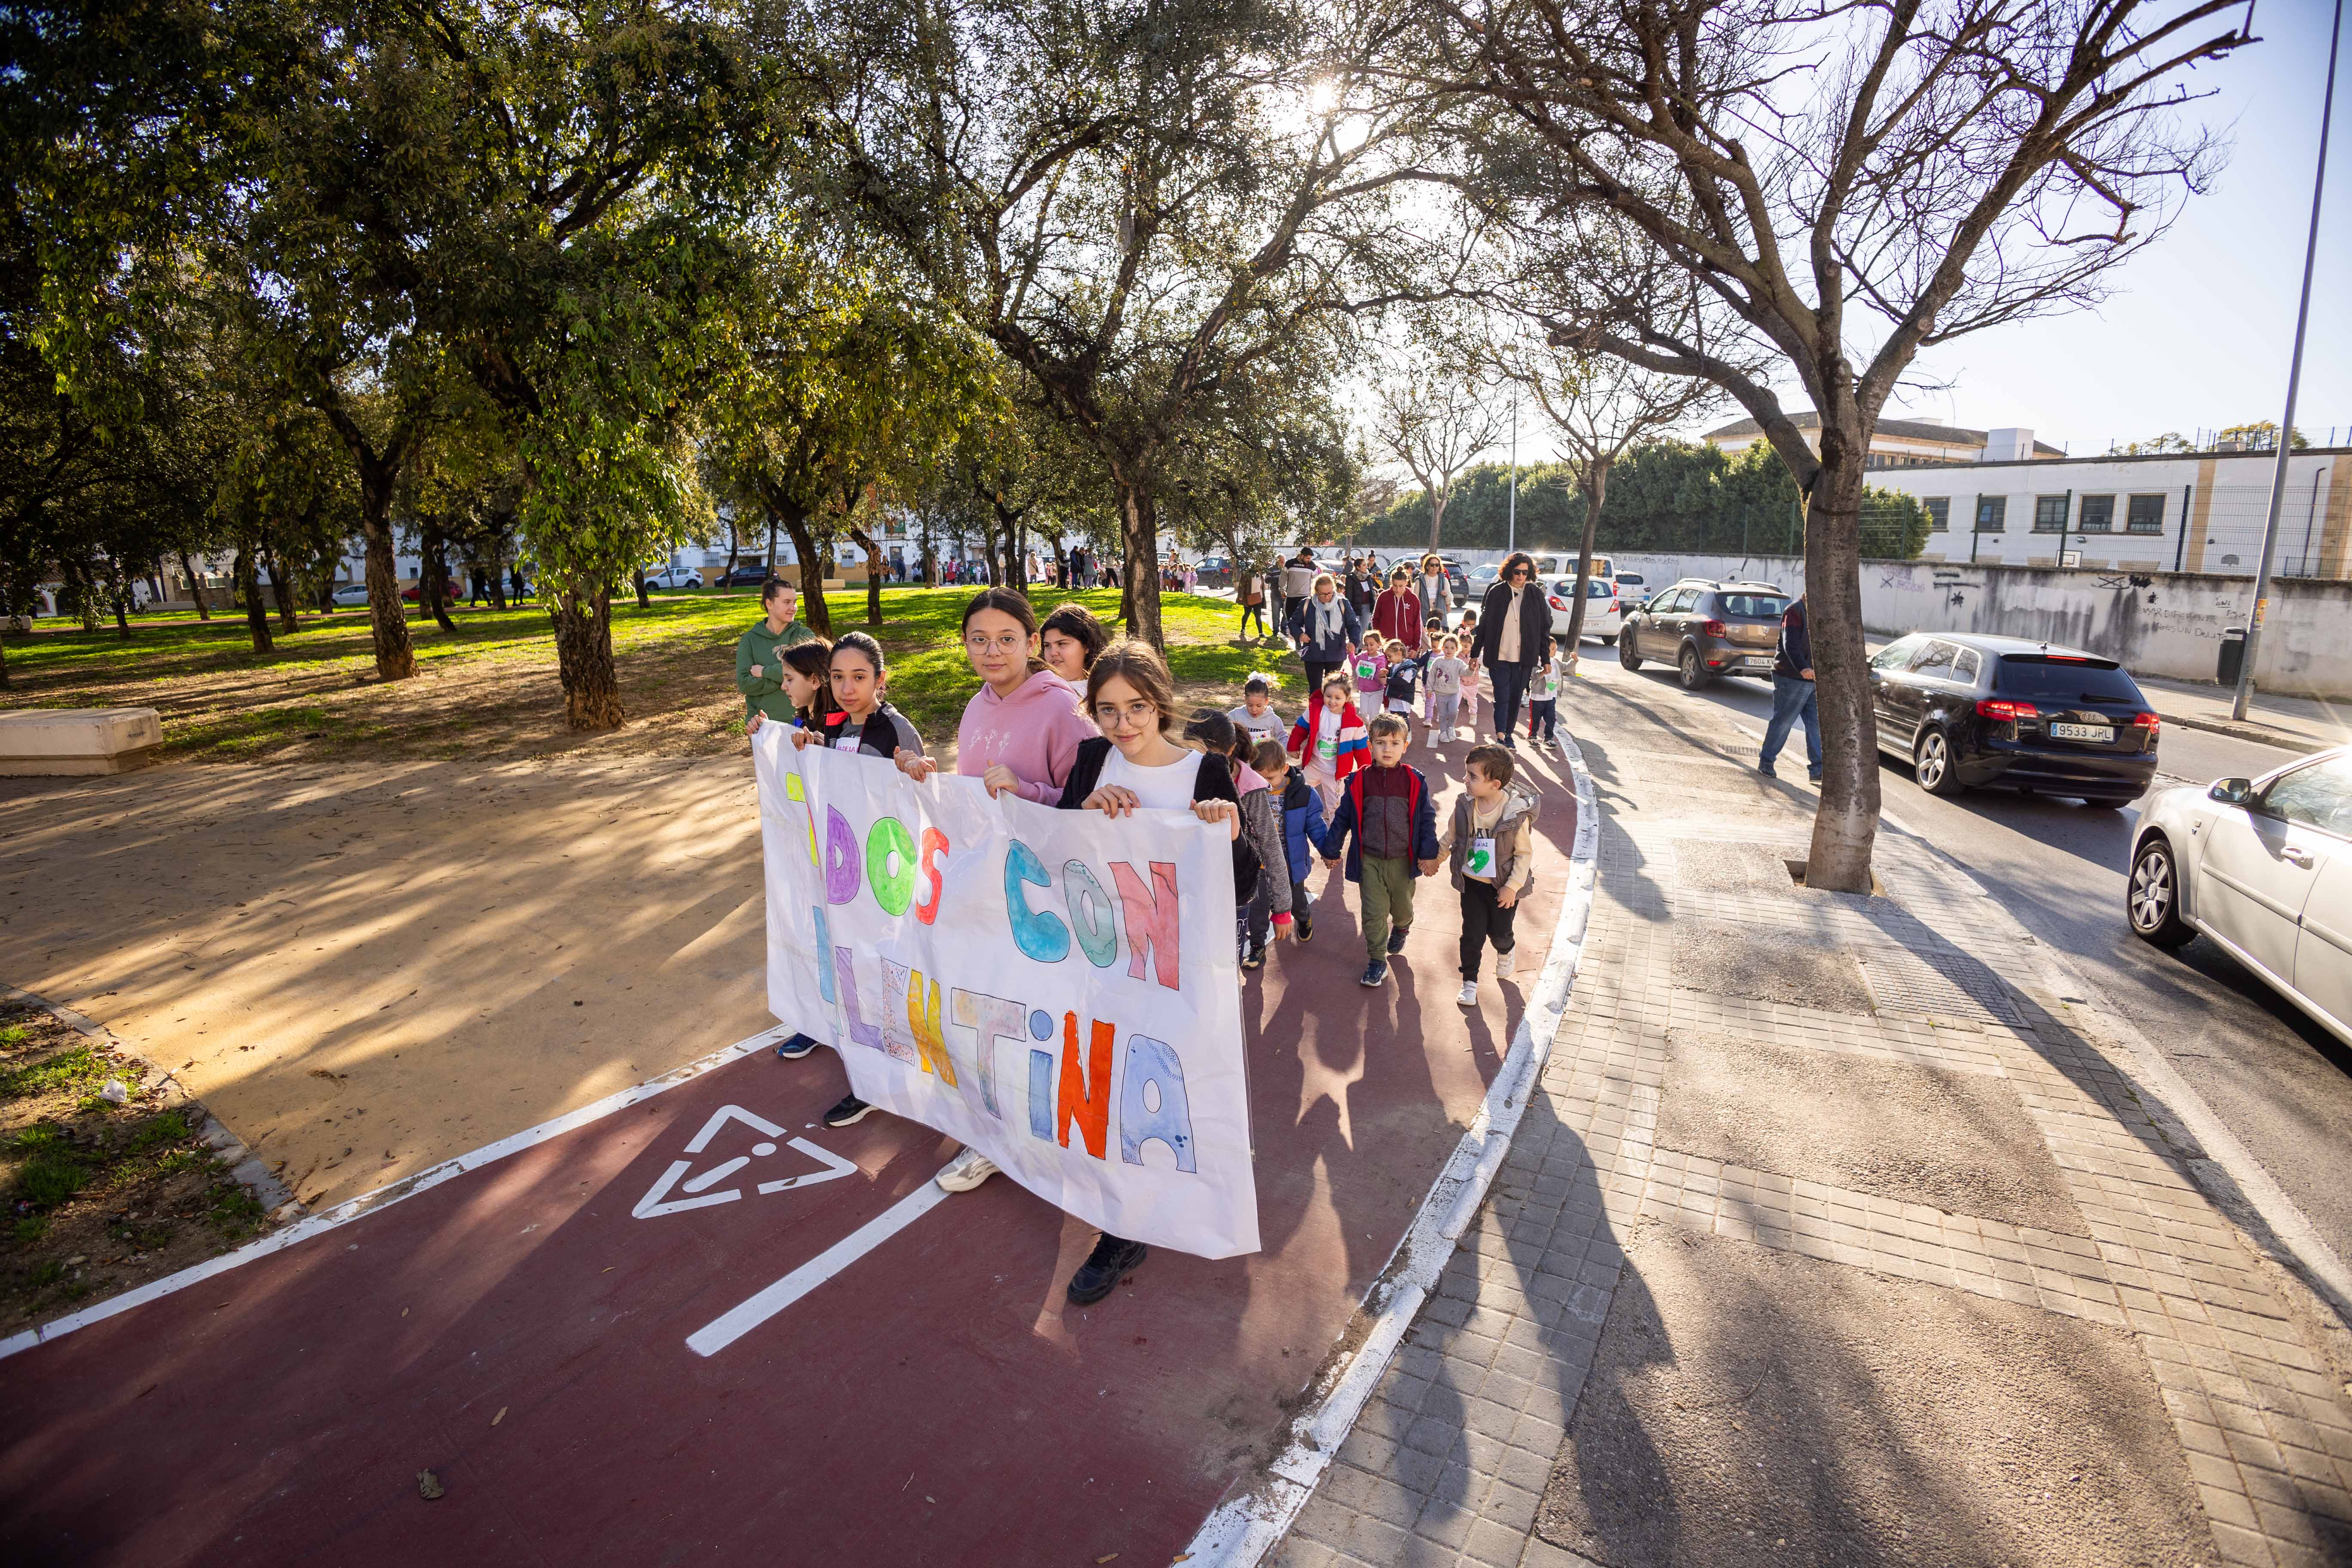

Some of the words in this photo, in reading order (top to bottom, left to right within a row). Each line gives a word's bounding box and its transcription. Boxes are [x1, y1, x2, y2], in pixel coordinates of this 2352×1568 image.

[2059, 725, 2087, 737] 9533
[2091, 727, 2110, 739] JRL
[1004, 839, 1179, 991] CON
